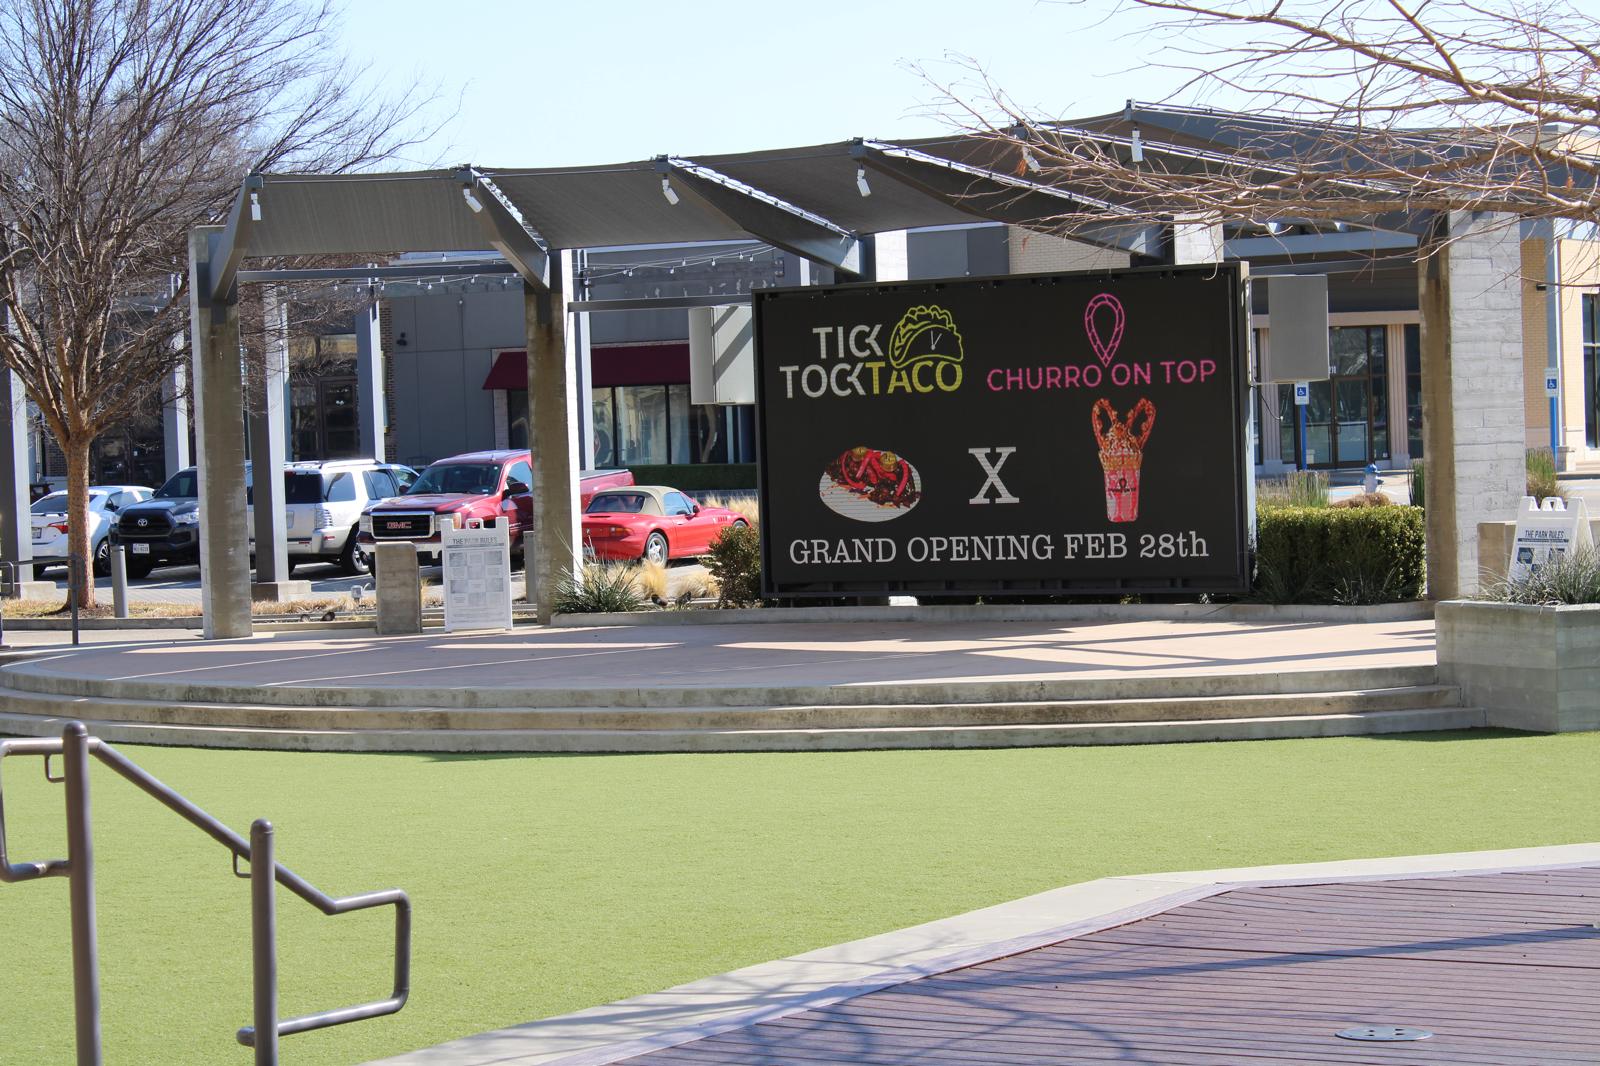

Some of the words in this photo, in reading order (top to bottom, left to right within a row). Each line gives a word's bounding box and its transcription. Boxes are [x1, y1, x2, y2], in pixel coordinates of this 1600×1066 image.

[813, 324, 884, 359] TICK
[987, 365, 1102, 391] CHURRO
[1111, 362, 1151, 386] ON
[1160, 360, 1217, 383] TOP
[968, 446, 1020, 504] X
[387, 521, 412, 529] GMC
[789, 538, 897, 564] GRAND
[907, 535, 1055, 562] OPENING
[1064, 533, 1128, 559] FEB
[1140, 531, 1210, 558] 28th
